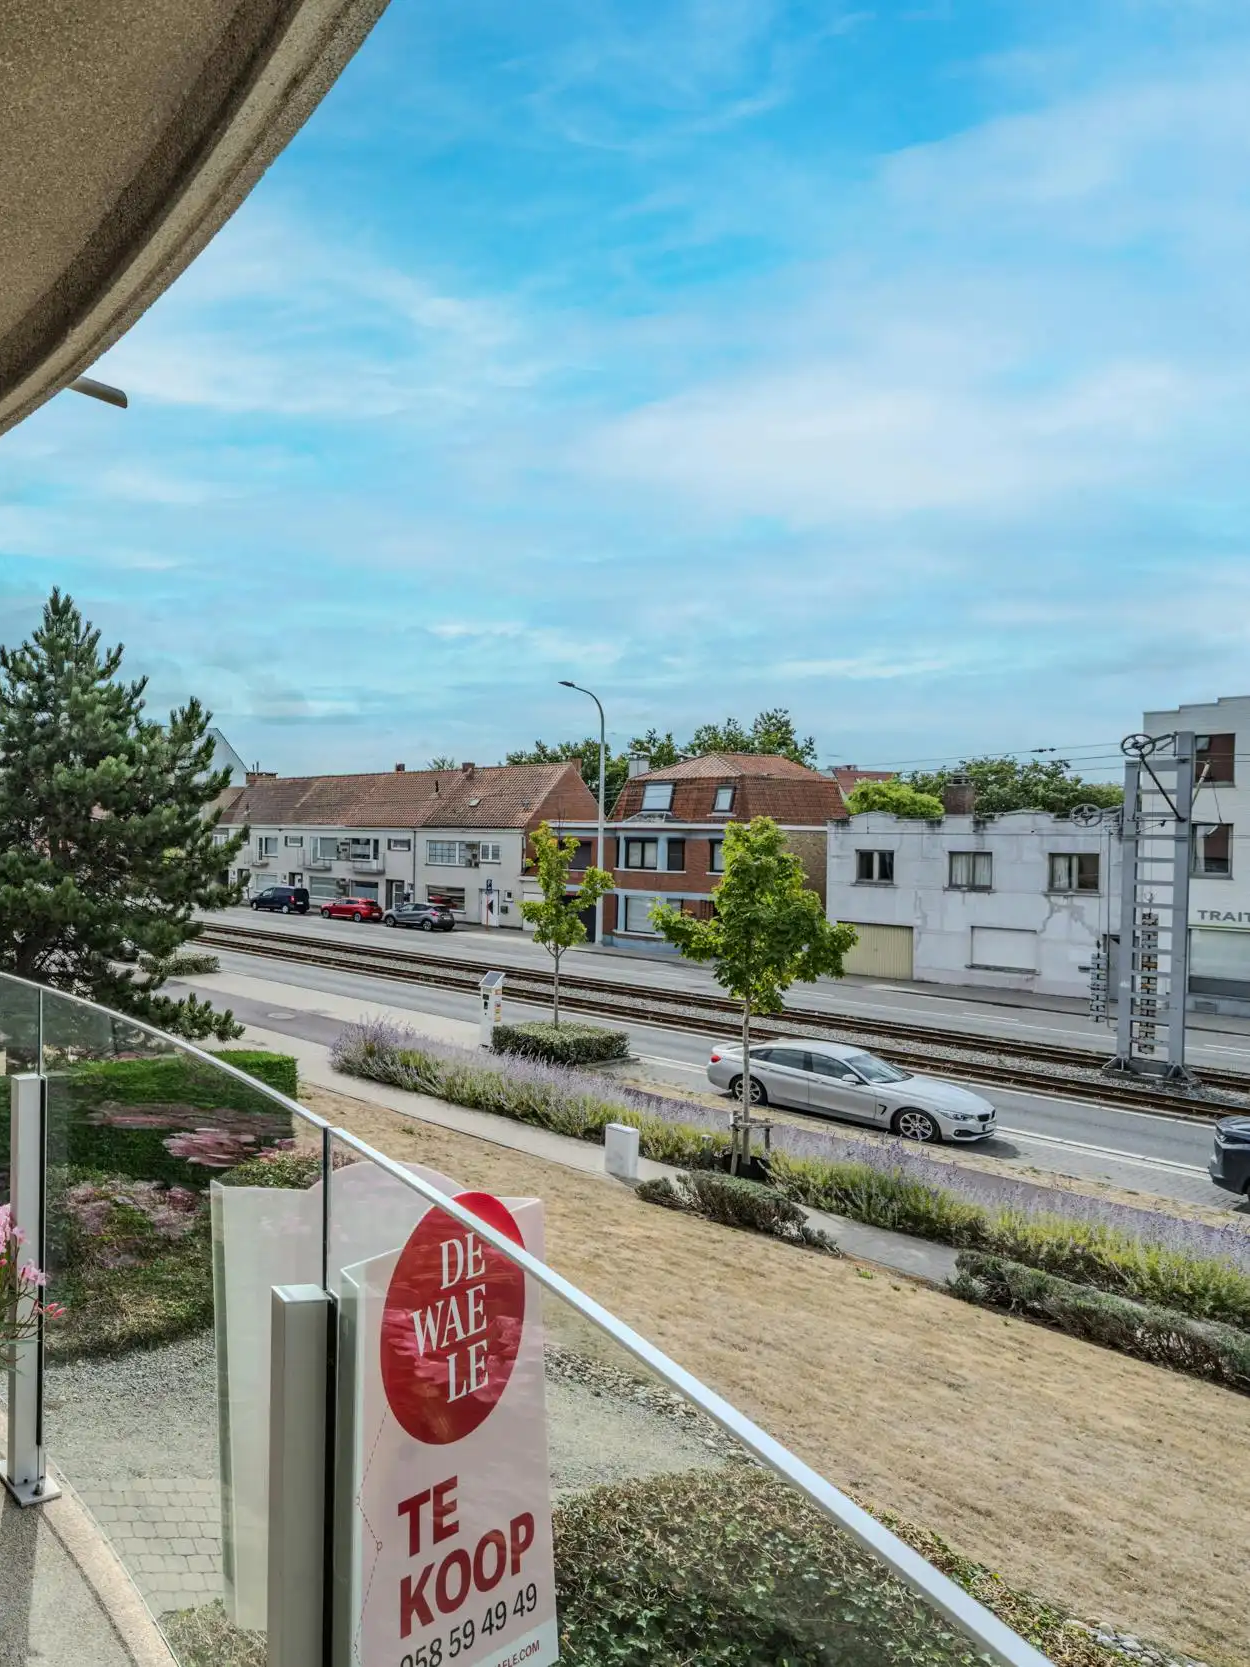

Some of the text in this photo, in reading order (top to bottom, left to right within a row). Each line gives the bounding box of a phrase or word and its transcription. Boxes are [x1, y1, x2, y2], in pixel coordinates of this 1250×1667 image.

[1197, 910, 1250, 923] TRAIT
[439, 1231, 486, 1290] DE
[411, 1283, 487, 1357] WAE
[446, 1339, 489, 1404] LE
[397, 1474, 460, 1558] TE
[400, 1511, 535, 1640] KOOP
[449, 1619, 476, 1658] 59
[481, 1600, 507, 1636] 49
[512, 1583, 538, 1618] 49
[497, 1639, 540, 1667] ELE.COM
